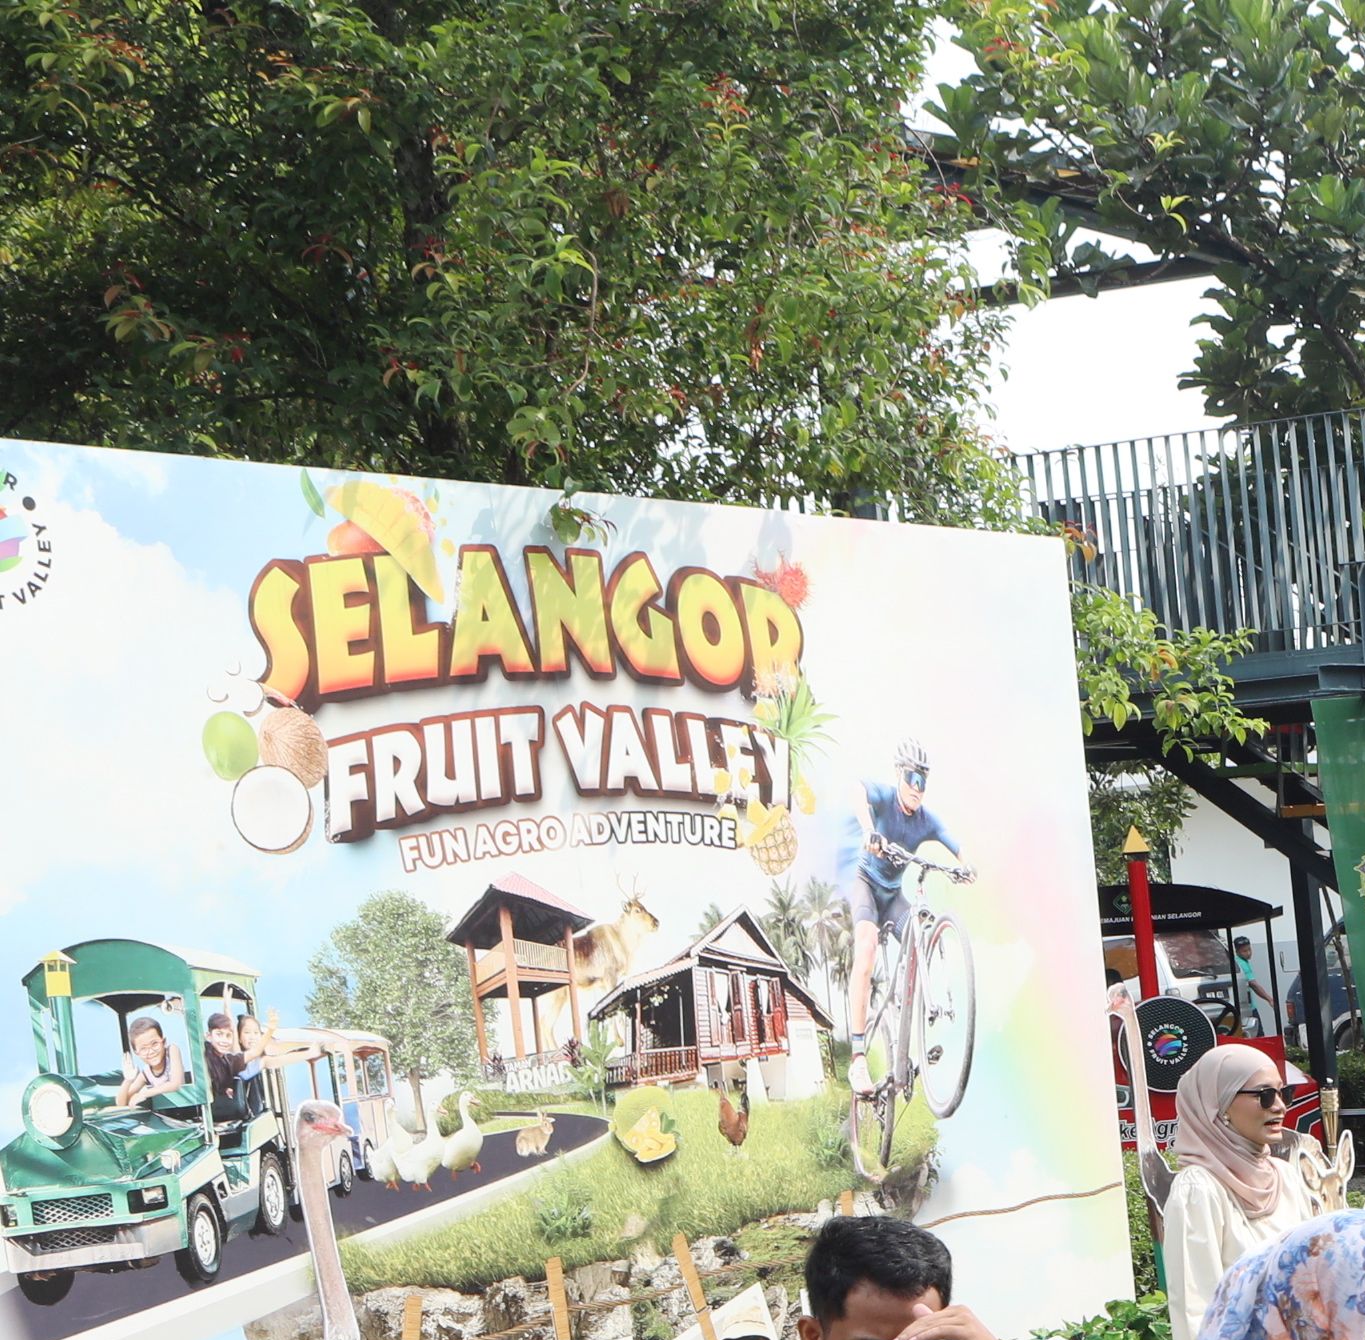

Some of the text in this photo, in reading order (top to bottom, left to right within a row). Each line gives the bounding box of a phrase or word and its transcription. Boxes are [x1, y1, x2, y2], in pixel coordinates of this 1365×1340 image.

[12, 523, 52, 605] VALLEY
[249, 544, 804, 714] SELANGOR
[324, 702, 792, 843] FRUIT VALLEY
[399, 811, 738, 873] FUN AGRO ADVENTURE
[1167, 911, 1202, 920] SELANGOR
